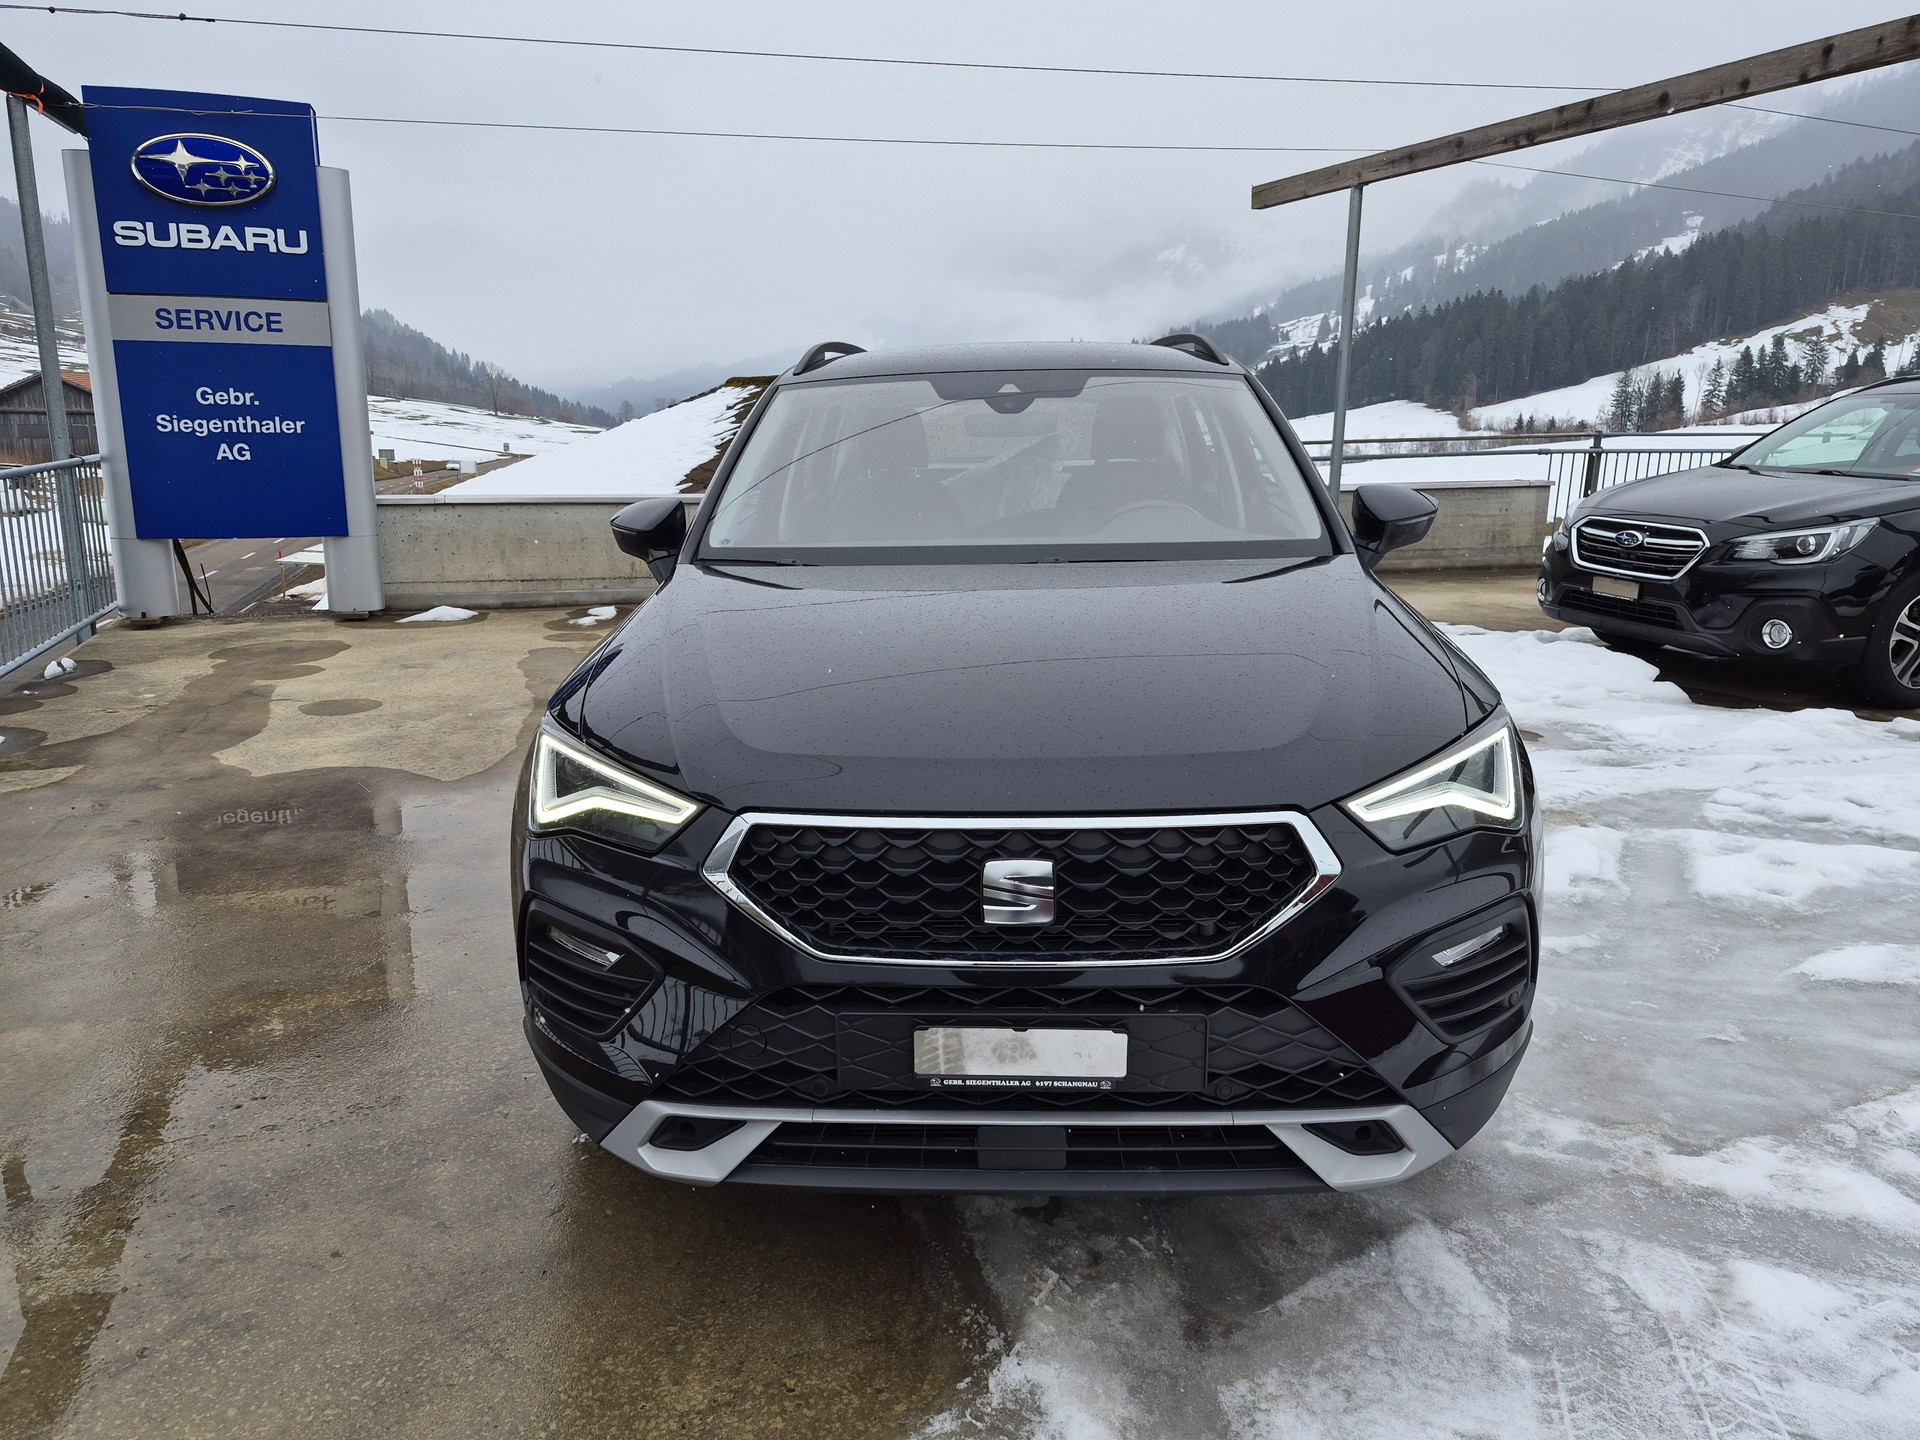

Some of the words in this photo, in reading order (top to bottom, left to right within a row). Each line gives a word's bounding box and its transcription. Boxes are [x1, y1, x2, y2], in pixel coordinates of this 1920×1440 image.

[113, 221, 308, 254] SUBARU
[154, 307, 284, 333] SERVICE
[195, 387, 260, 405] Gebr.
[156, 414, 305, 437] Siegenthaler
[216, 443, 251, 461] AG
[965, 1079, 1020, 1087] SIEGENTHALER
